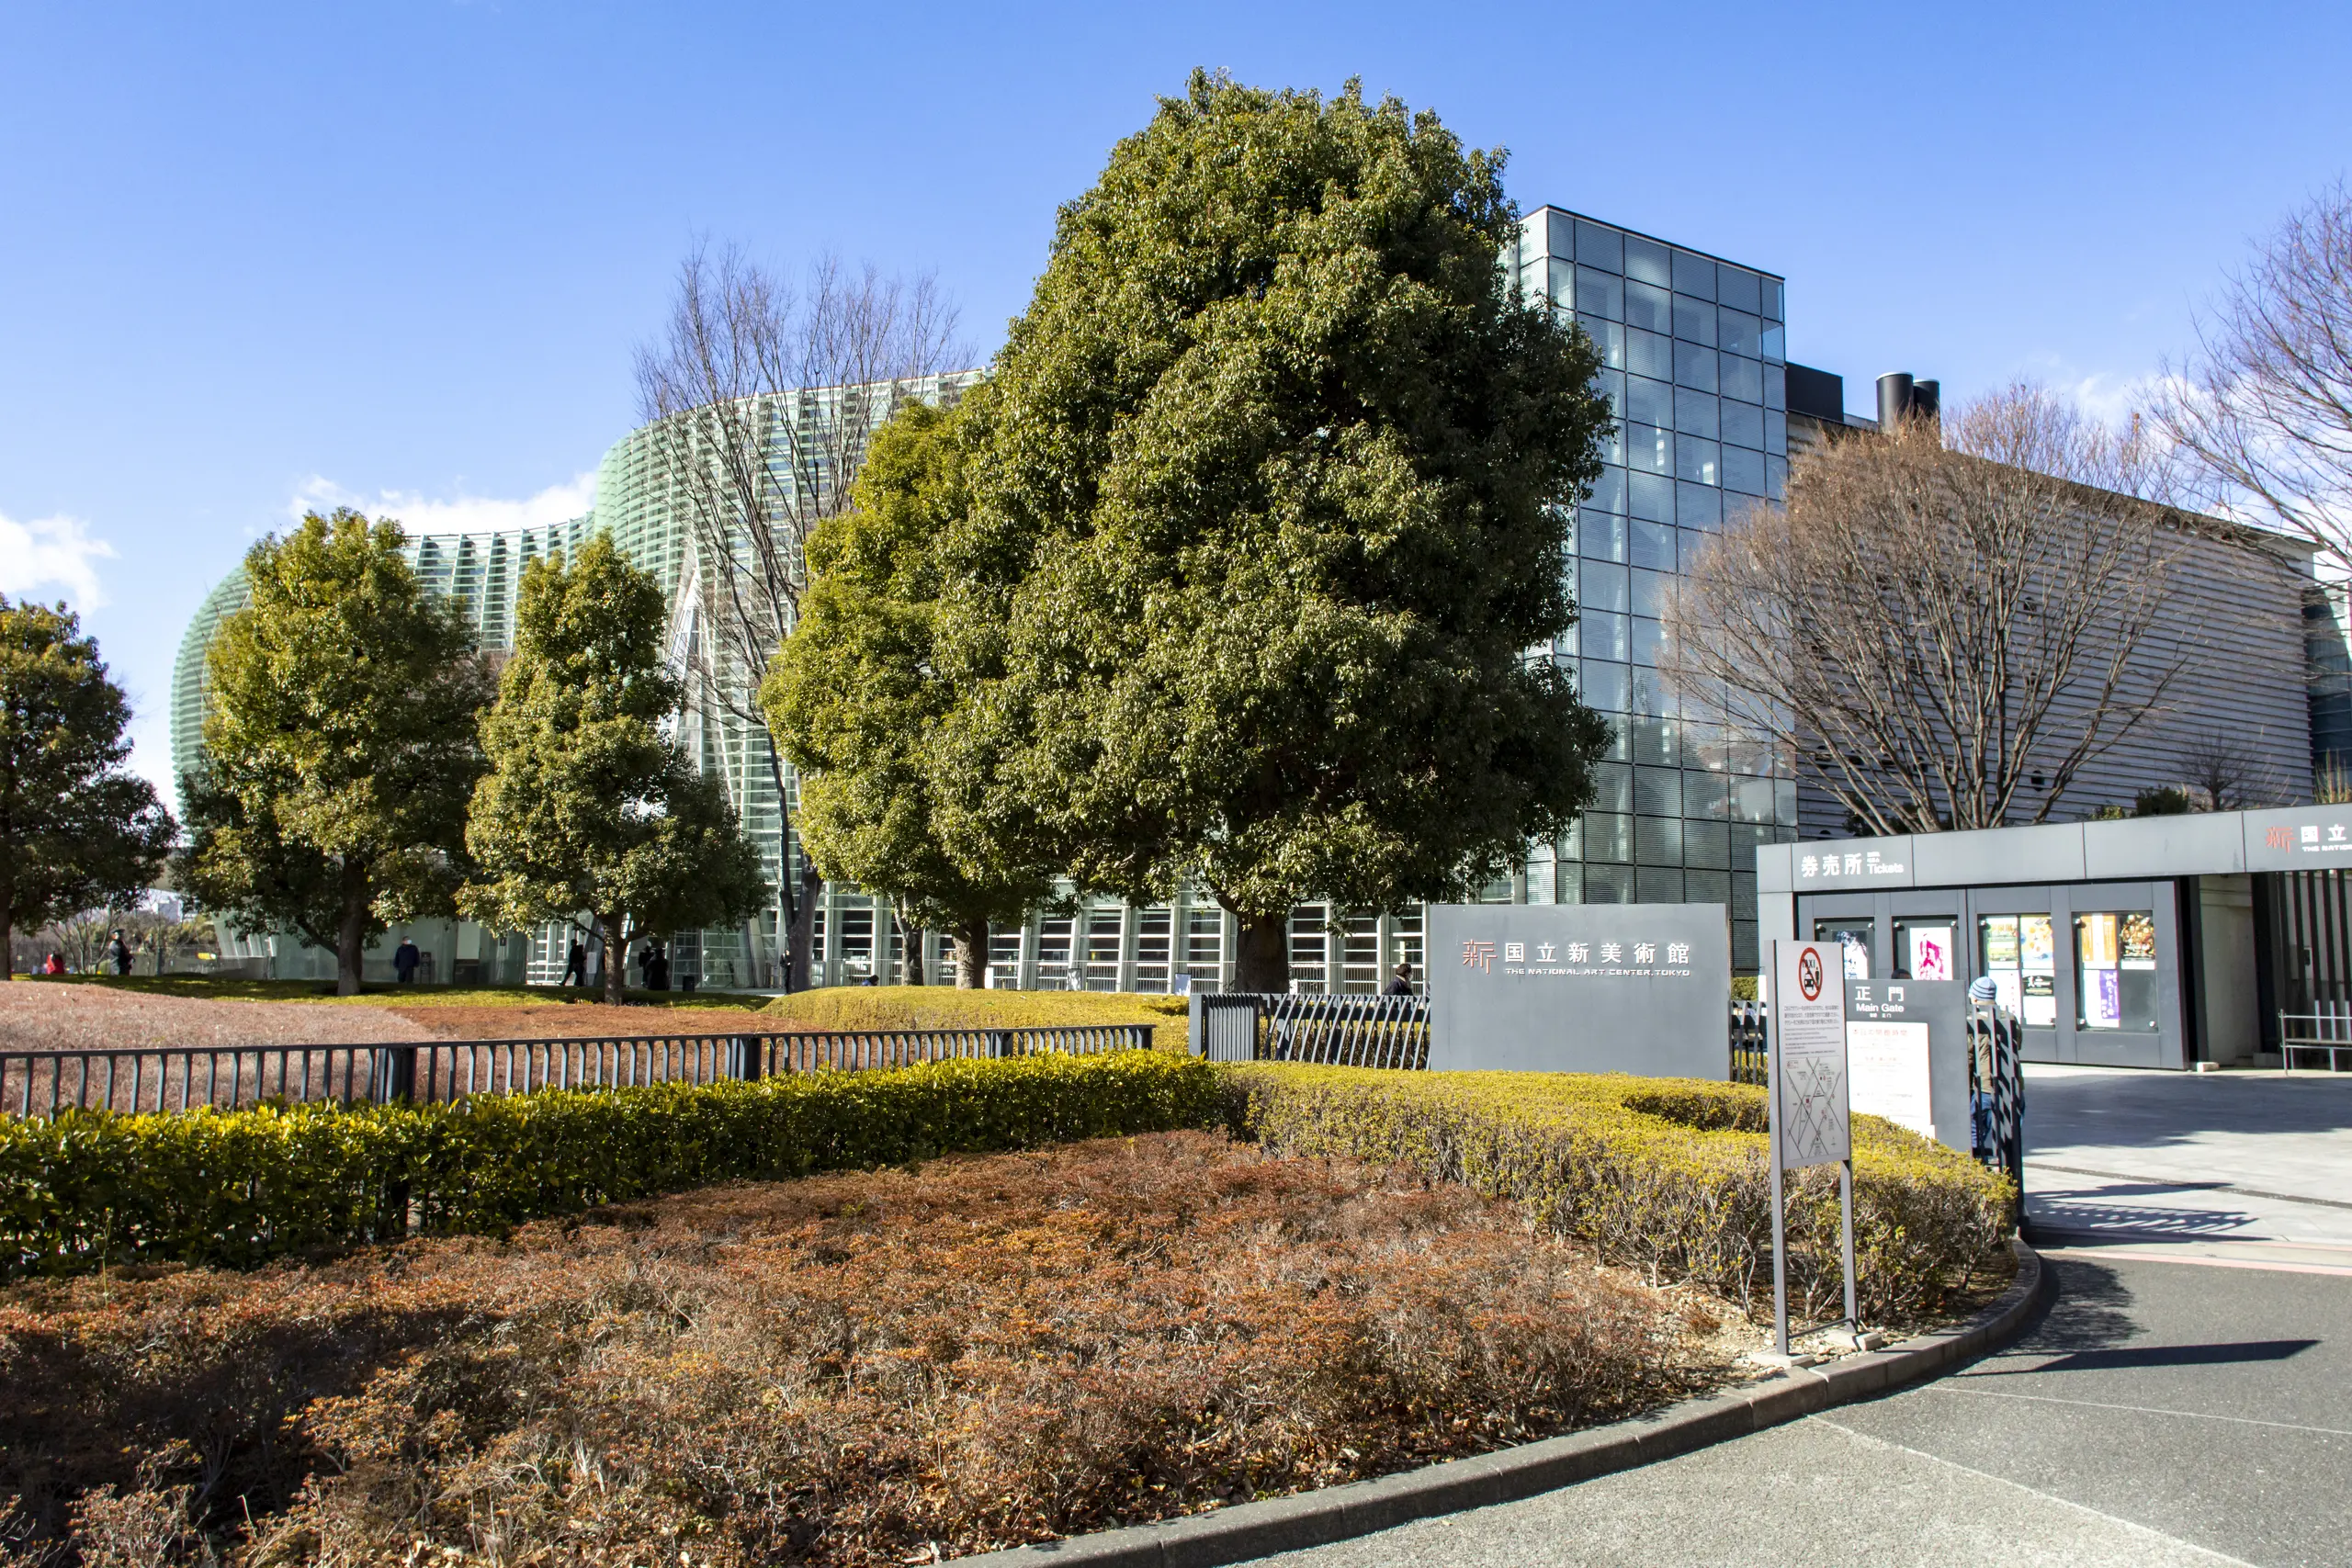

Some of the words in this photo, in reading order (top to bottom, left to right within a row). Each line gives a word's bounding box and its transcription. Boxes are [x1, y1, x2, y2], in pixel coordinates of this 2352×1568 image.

[2301, 824, 2347, 843] 国立
[1801, 852, 1862, 878] 券売所
[1867, 863, 1905, 874] Tickets
[1504, 942, 1690, 964] 国立新美術館
[1802, 959, 1815, 968] TAXI
[1855, 986, 1905, 1001] 正門
[1856, 1003, 1879, 1011] Main
[1881, 1003, 1905, 1012] Gate
